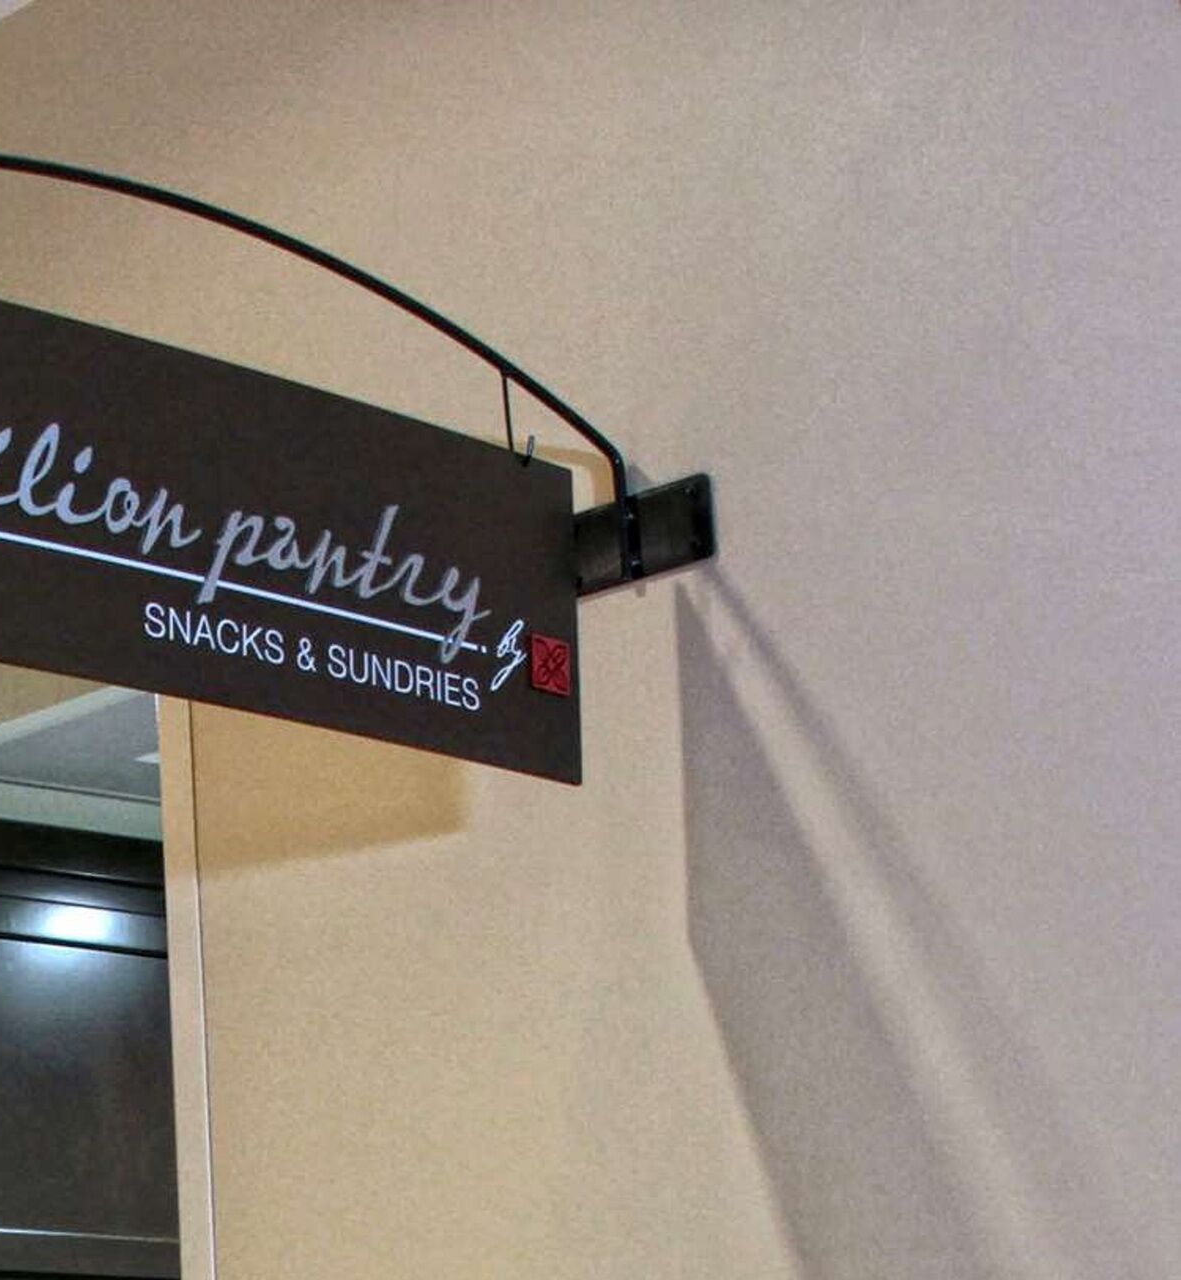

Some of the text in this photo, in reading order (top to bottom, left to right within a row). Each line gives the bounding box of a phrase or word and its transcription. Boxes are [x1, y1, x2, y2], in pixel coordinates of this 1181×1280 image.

[197, 504, 492, 664] pantry
[142, 601, 482, 712] SNACKS & SUNDRIES
[490, 618, 527, 692] by
